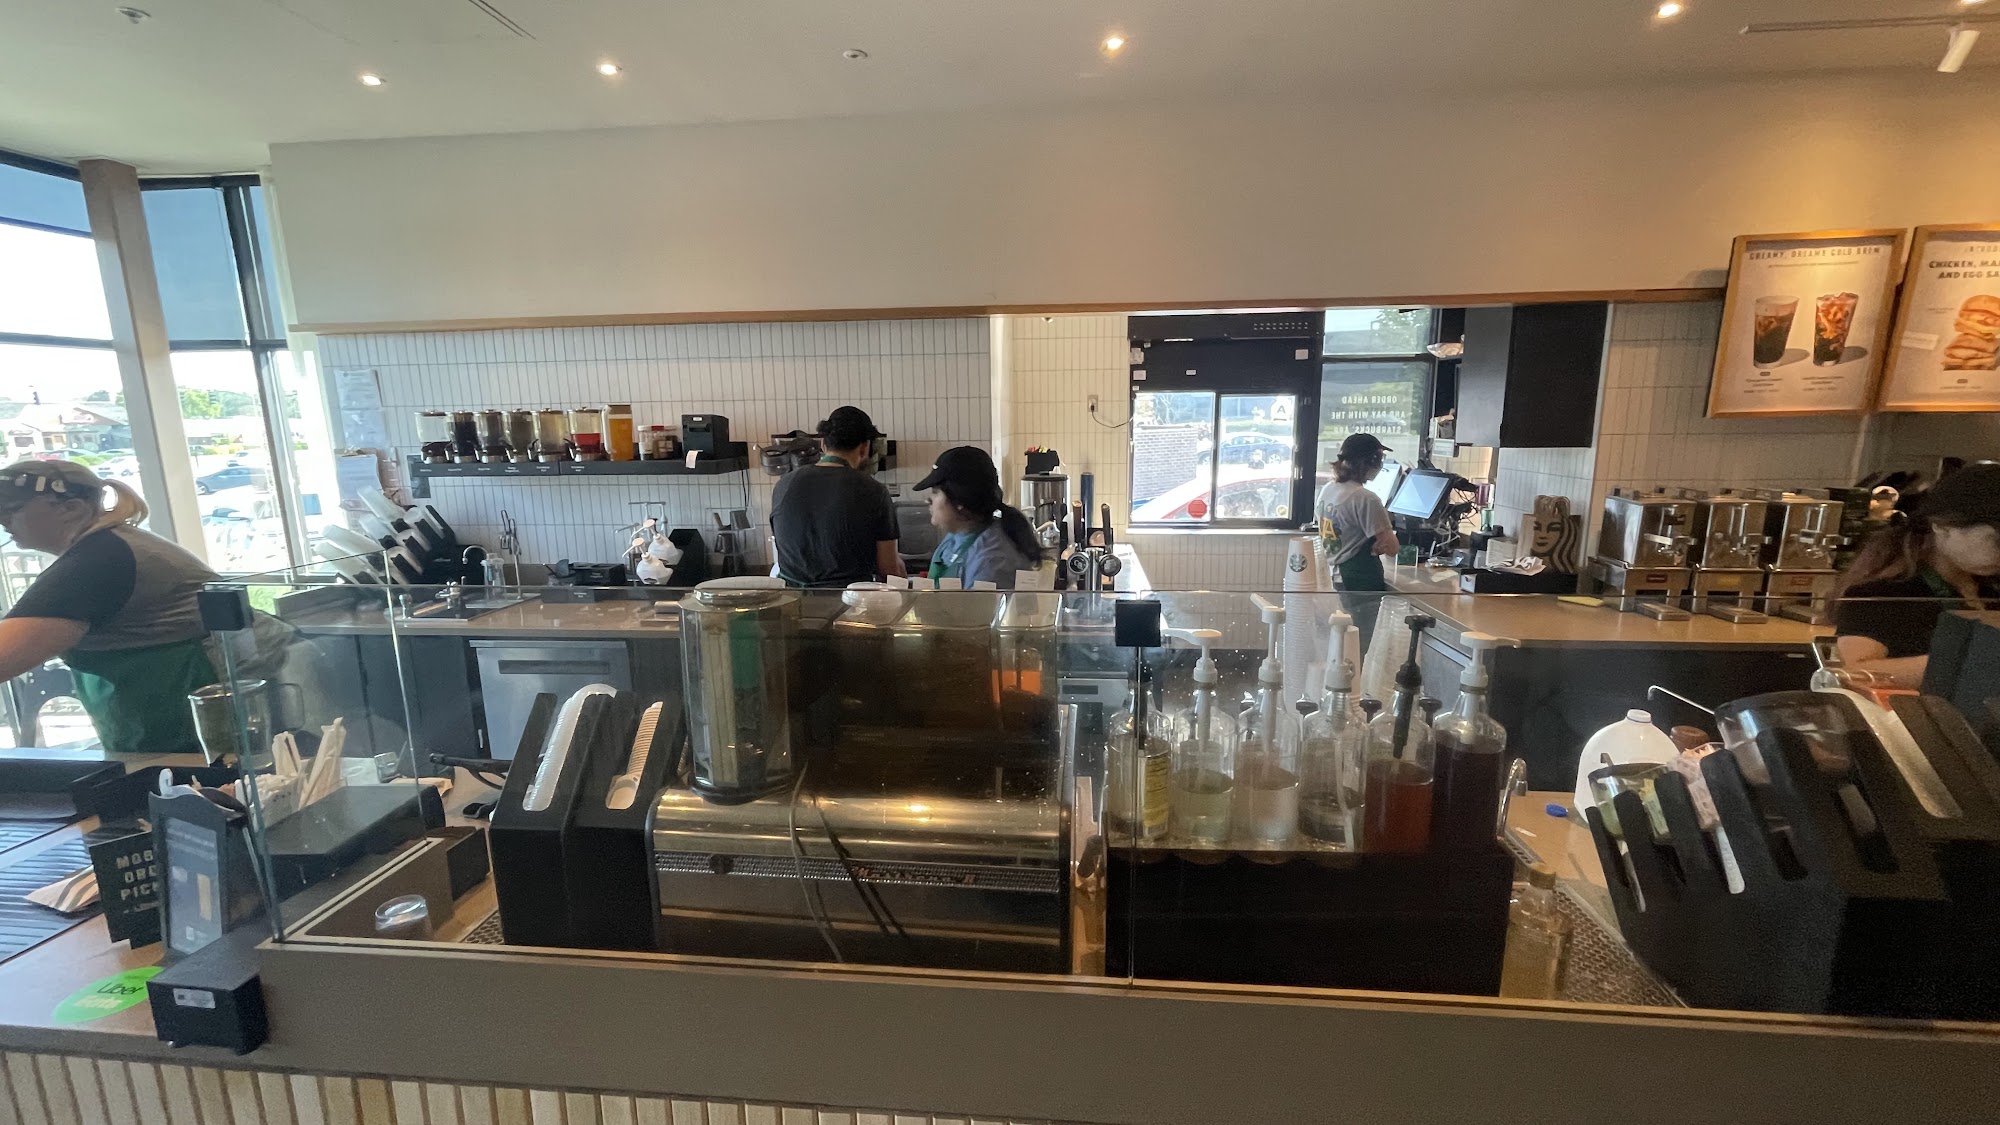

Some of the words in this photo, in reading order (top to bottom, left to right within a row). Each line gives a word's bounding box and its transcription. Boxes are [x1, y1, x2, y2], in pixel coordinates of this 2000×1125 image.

[1831, 248, 1852, 257] COLD
[1856, 247, 1880, 255] BREW
[1938, 270, 1961, 280] AND
[1963, 270, 1984, 279] EGG
[97, 982, 145, 996] Uber
